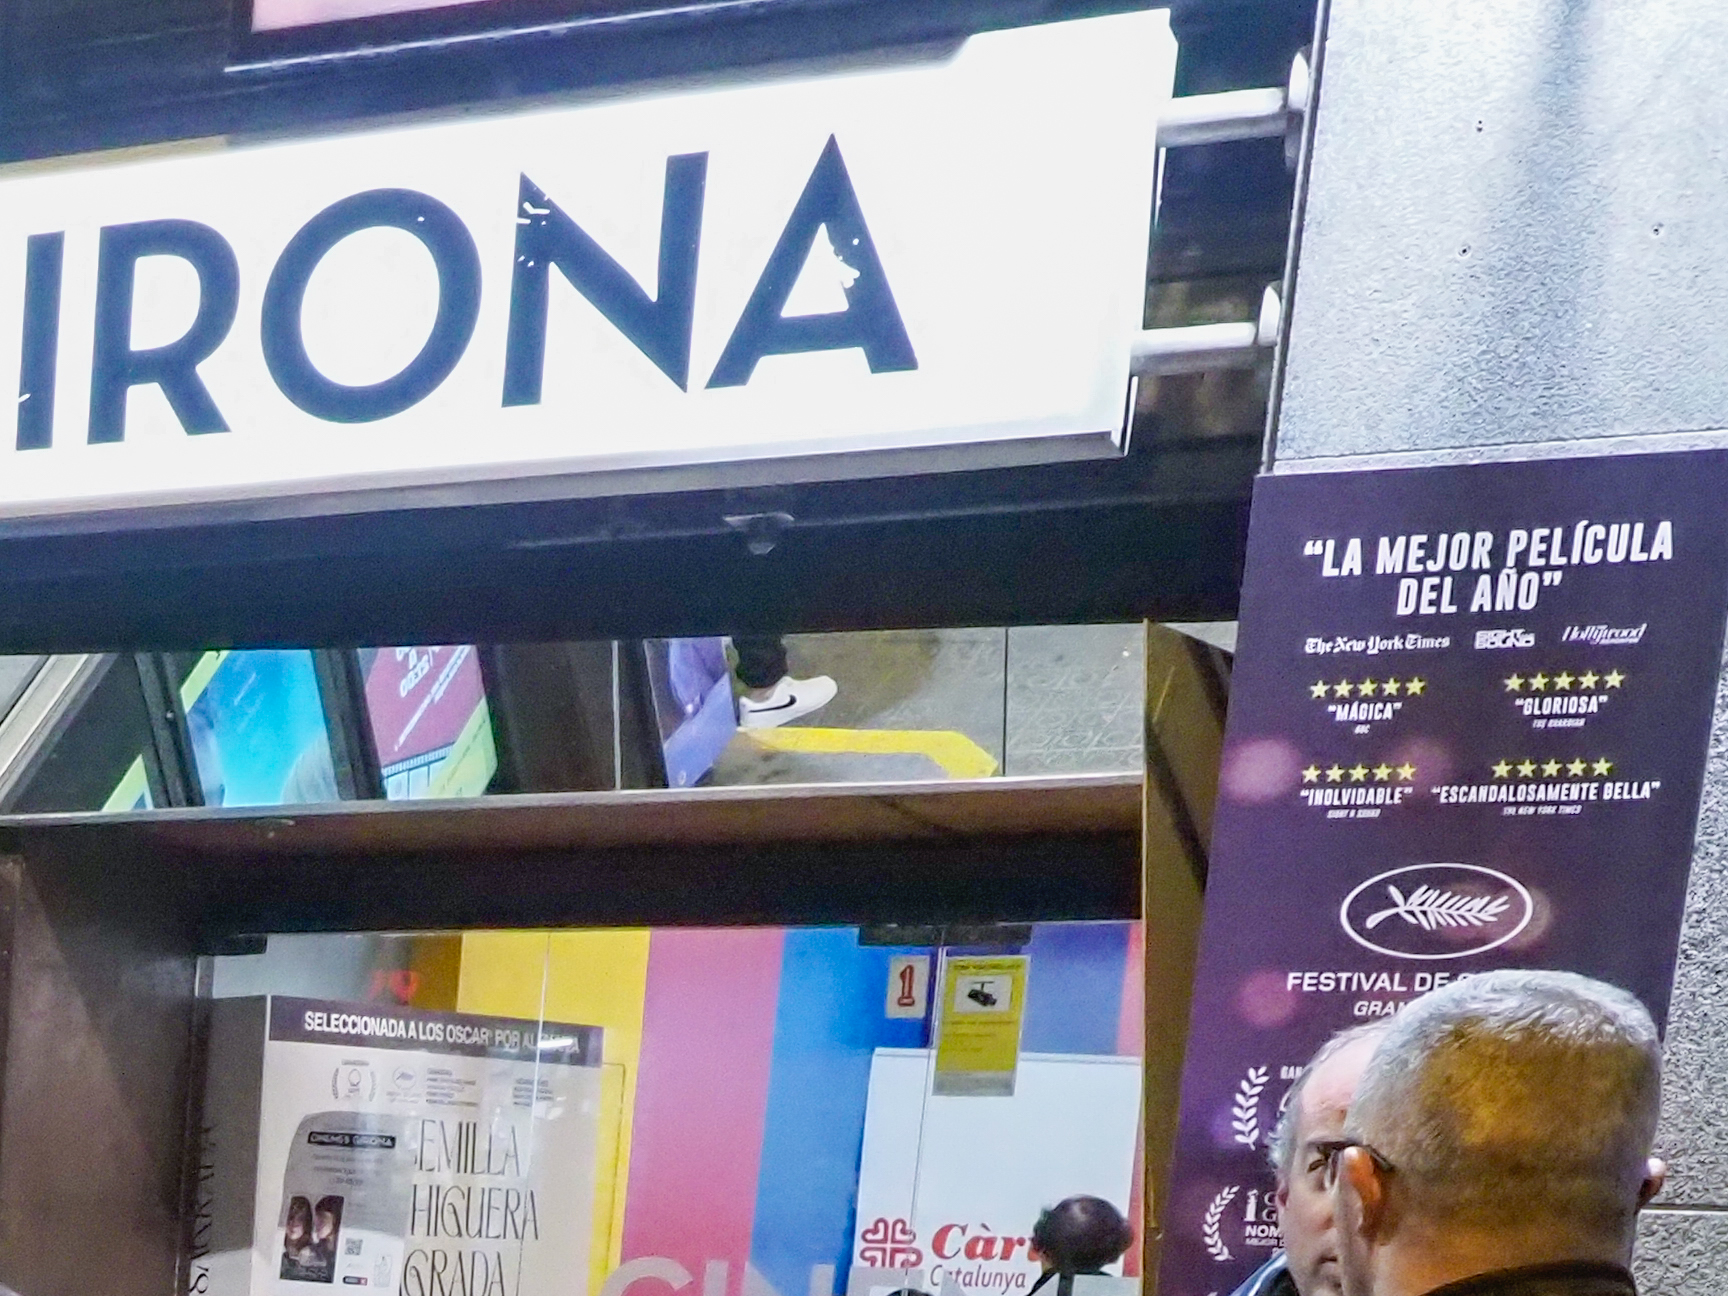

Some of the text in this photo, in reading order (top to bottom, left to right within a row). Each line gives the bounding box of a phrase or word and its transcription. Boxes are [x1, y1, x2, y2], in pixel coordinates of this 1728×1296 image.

[1304, 520, 1674, 577] “LA MEJOR PELÍCULA
[1396, 567, 1563, 616] DEL AÑO”
[897, 964, 915, 1007] 1
[1287, 972, 1448, 992] FESTIVAL DE
[304, 1011, 407, 1038] SELECCIONADA
[408, 1025, 417, 1040] A
[417, 1022, 444, 1042] LOS
[419, 1119, 520, 1176] EMILLA
[411, 1183, 539, 1240] HIGUERA
